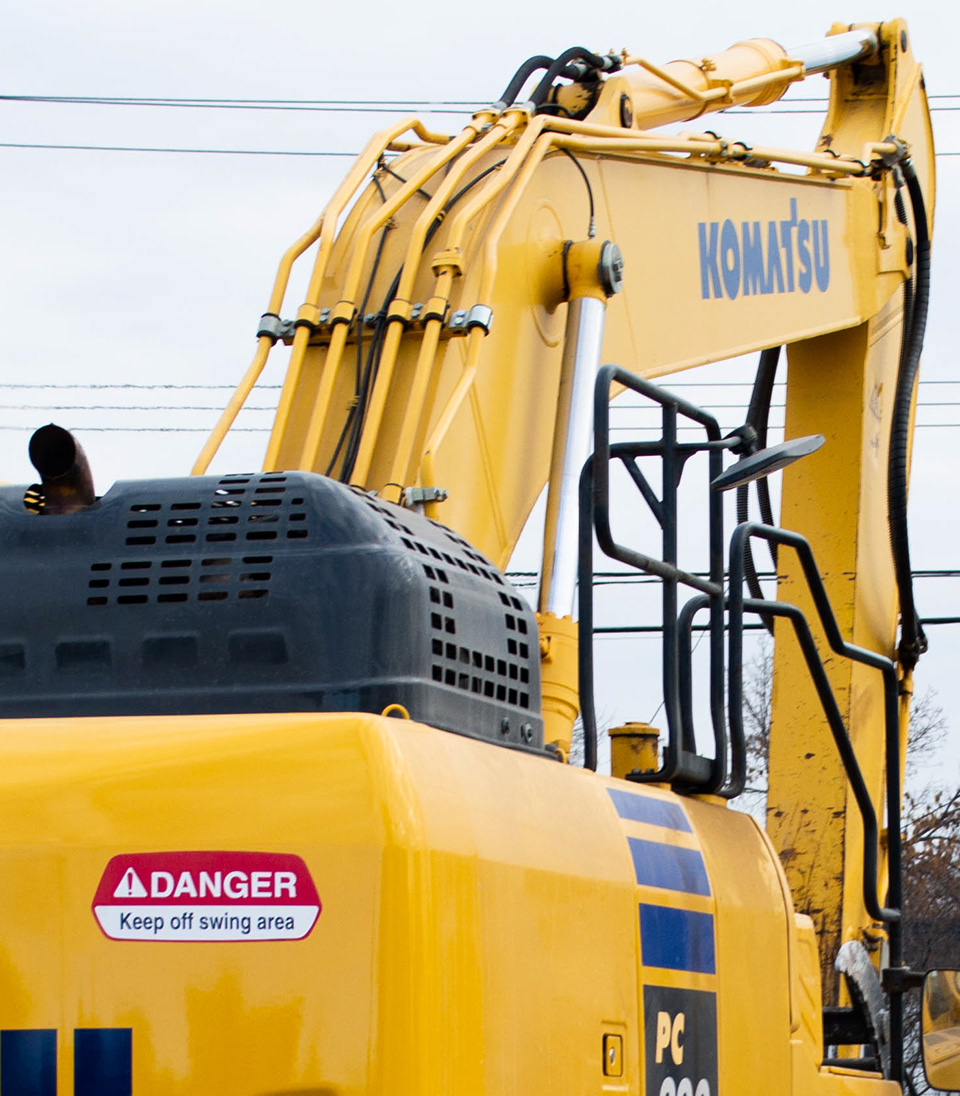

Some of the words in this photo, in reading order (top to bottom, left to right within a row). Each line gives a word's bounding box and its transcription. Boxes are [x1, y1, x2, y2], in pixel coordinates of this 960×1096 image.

[697, 197, 830, 300] KOMATSU
[150, 870, 298, 899] DANGER
[119, 912, 164, 935] Keep
[170, 912, 193, 931] off
[199, 912, 251, 935] swing
[257, 915, 295, 930] area
[655, 1011, 686, 1066] PC
